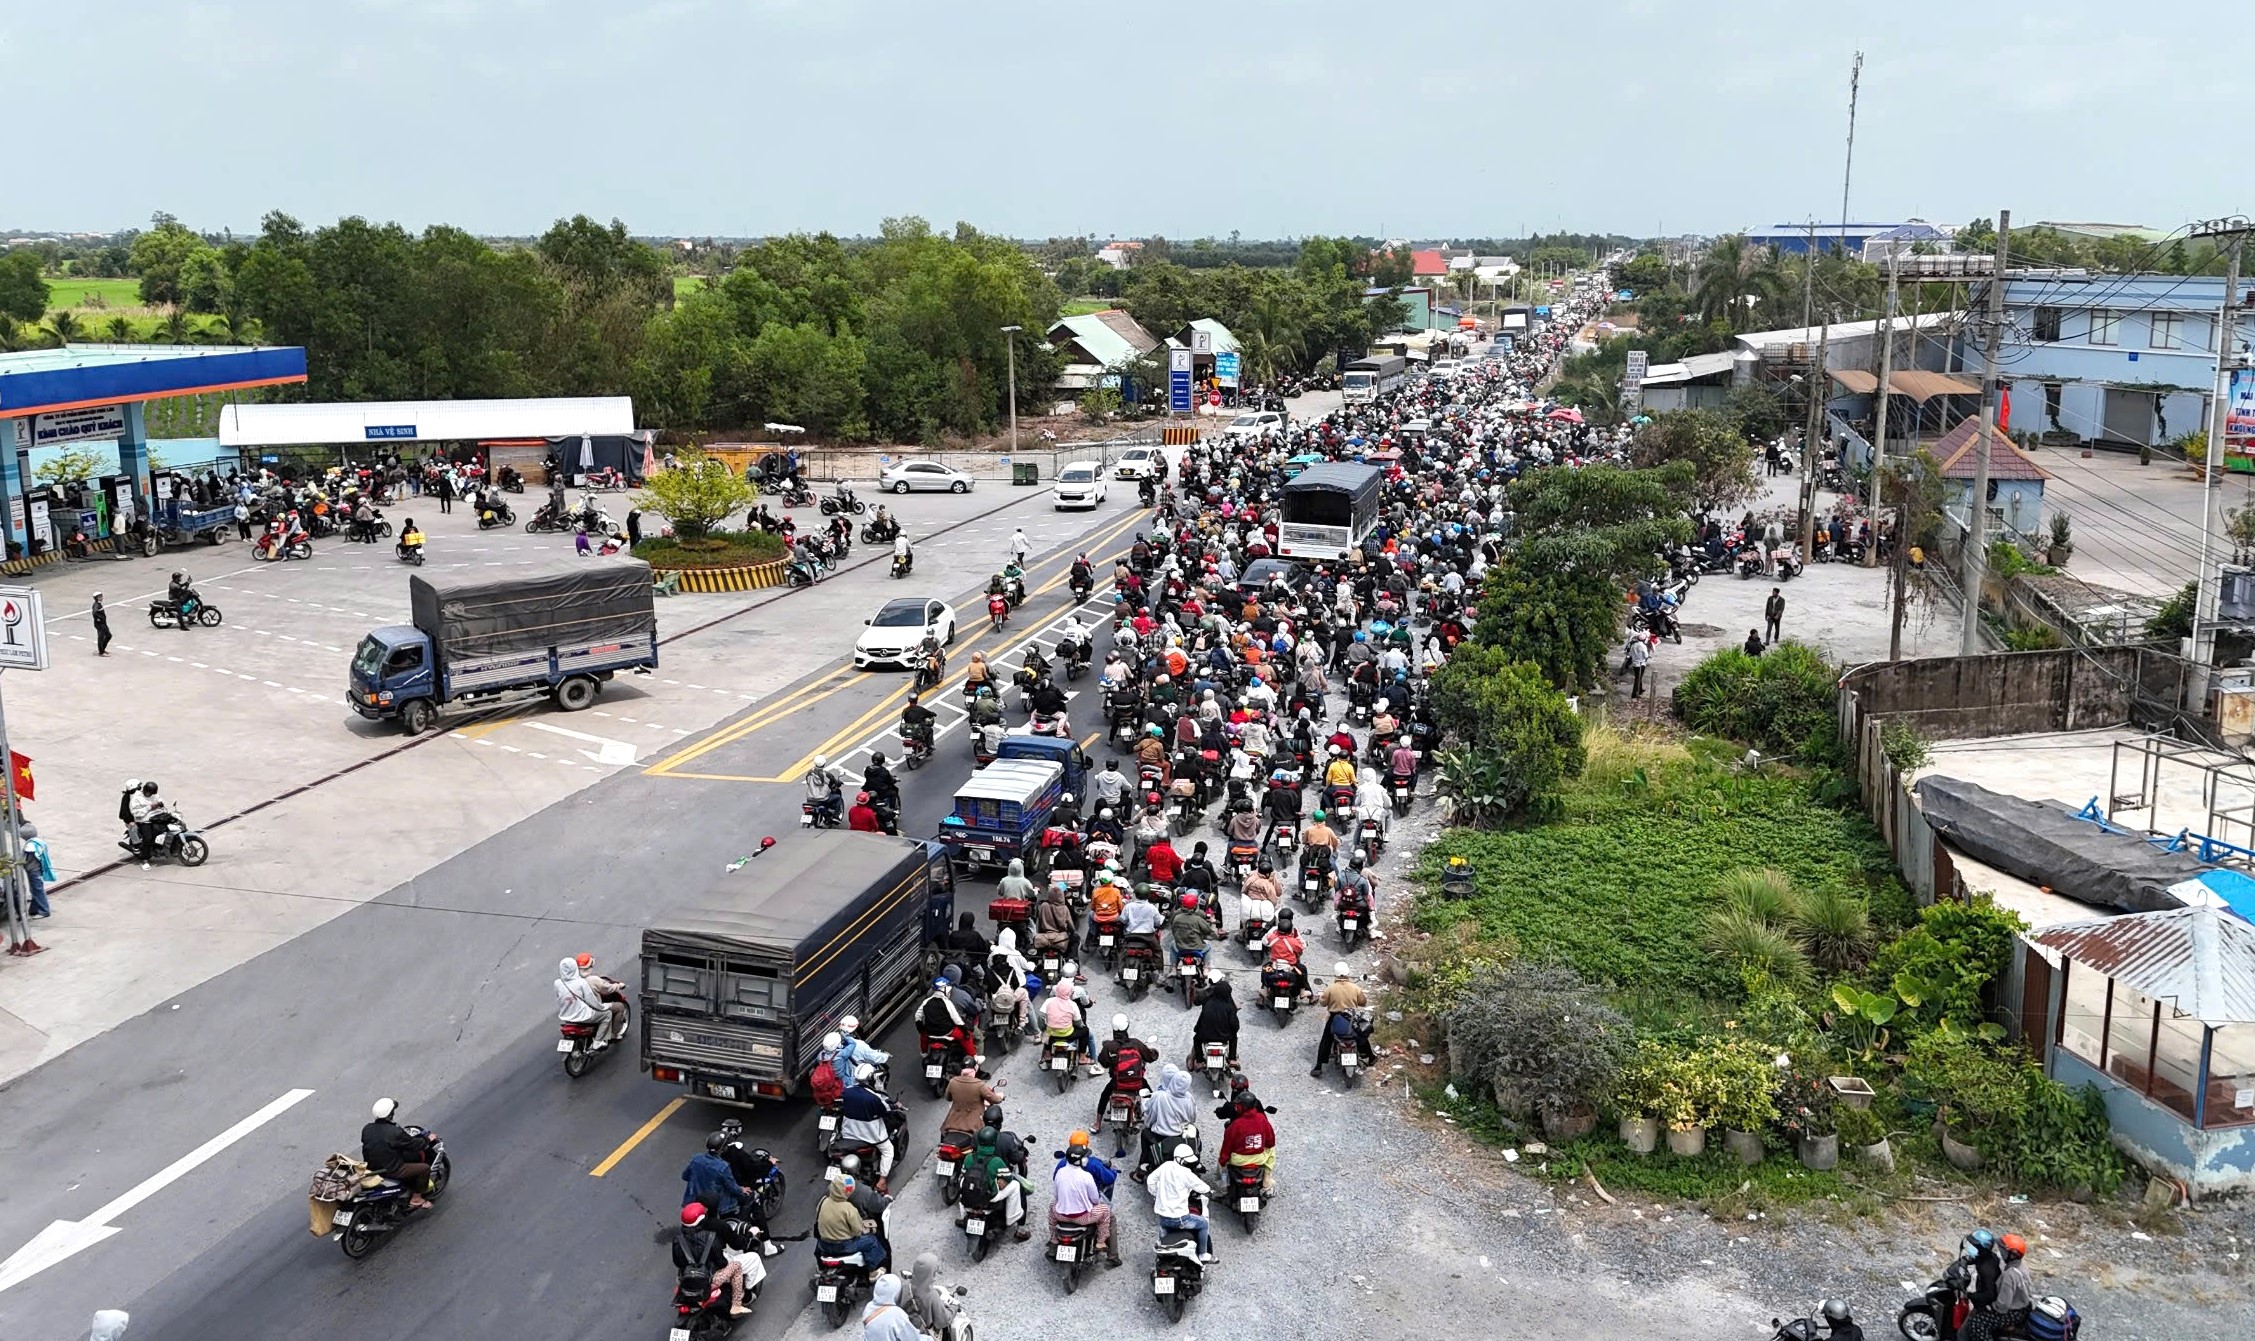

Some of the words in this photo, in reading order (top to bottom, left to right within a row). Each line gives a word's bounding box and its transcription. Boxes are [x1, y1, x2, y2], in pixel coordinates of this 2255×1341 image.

[37, 427, 58, 440] KÍNH
[58, 424, 80, 437] CHÀO
[81, 420, 97, 434] QUÝ
[98, 418, 123, 431] KHÁCH
[368, 427, 384, 436] NHÀ
[385, 427, 395, 436] VỆ
[396, 427, 413, 435] SINH
